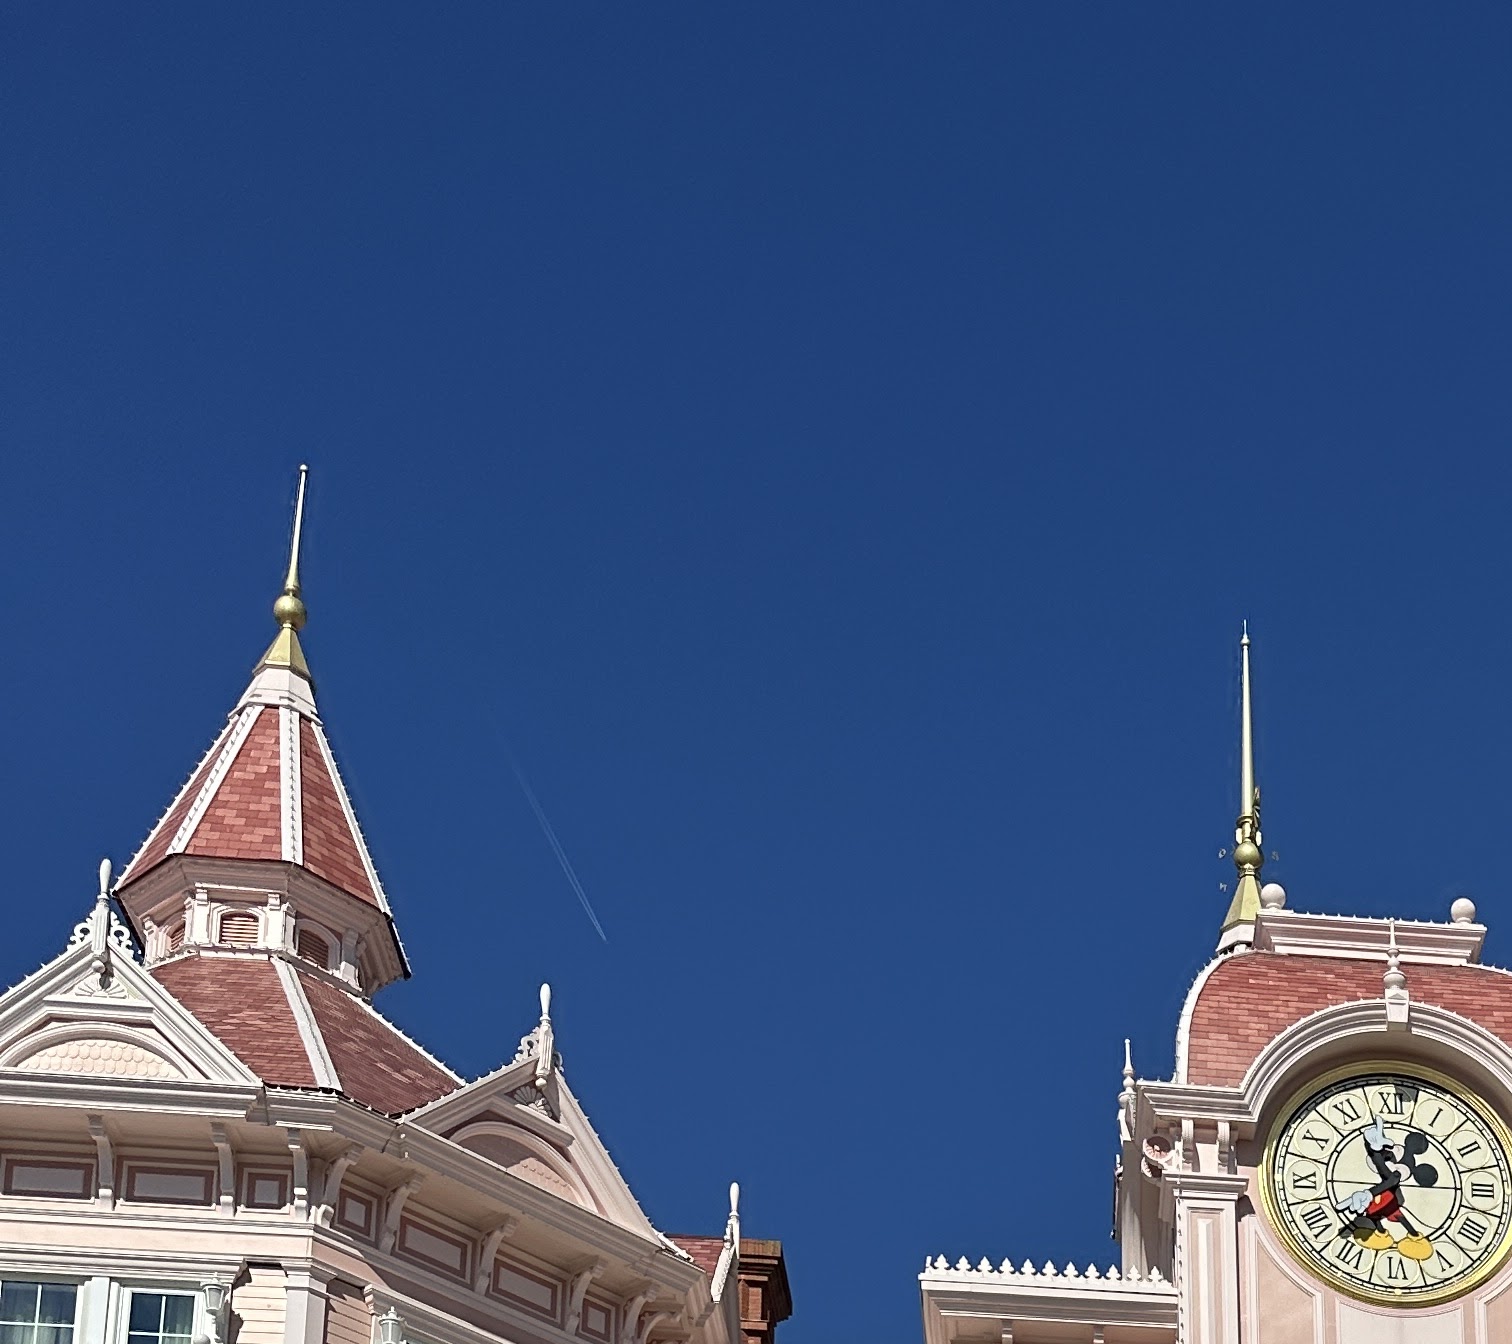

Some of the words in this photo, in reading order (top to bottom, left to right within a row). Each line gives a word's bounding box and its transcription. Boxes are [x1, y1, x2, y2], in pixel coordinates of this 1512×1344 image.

[1332, 1098, 1361, 1124] XI
[1378, 1091, 1404, 1115] XII
[1428, 1108, 1443, 1128] I
[1303, 1129, 1329, 1149] X
[1457, 1140, 1480, 1157] II
[1293, 1171, 1317, 1190] IX
[1471, 1182, 1494, 1199] III
[1301, 1206, 1333, 1240] VIII
[1458, 1216, 1487, 1246] IIII
[1335, 1240, 1365, 1270] VII
[1435, 1249, 1454, 1272] V
[1386, 1256, 1408, 1280] VI
